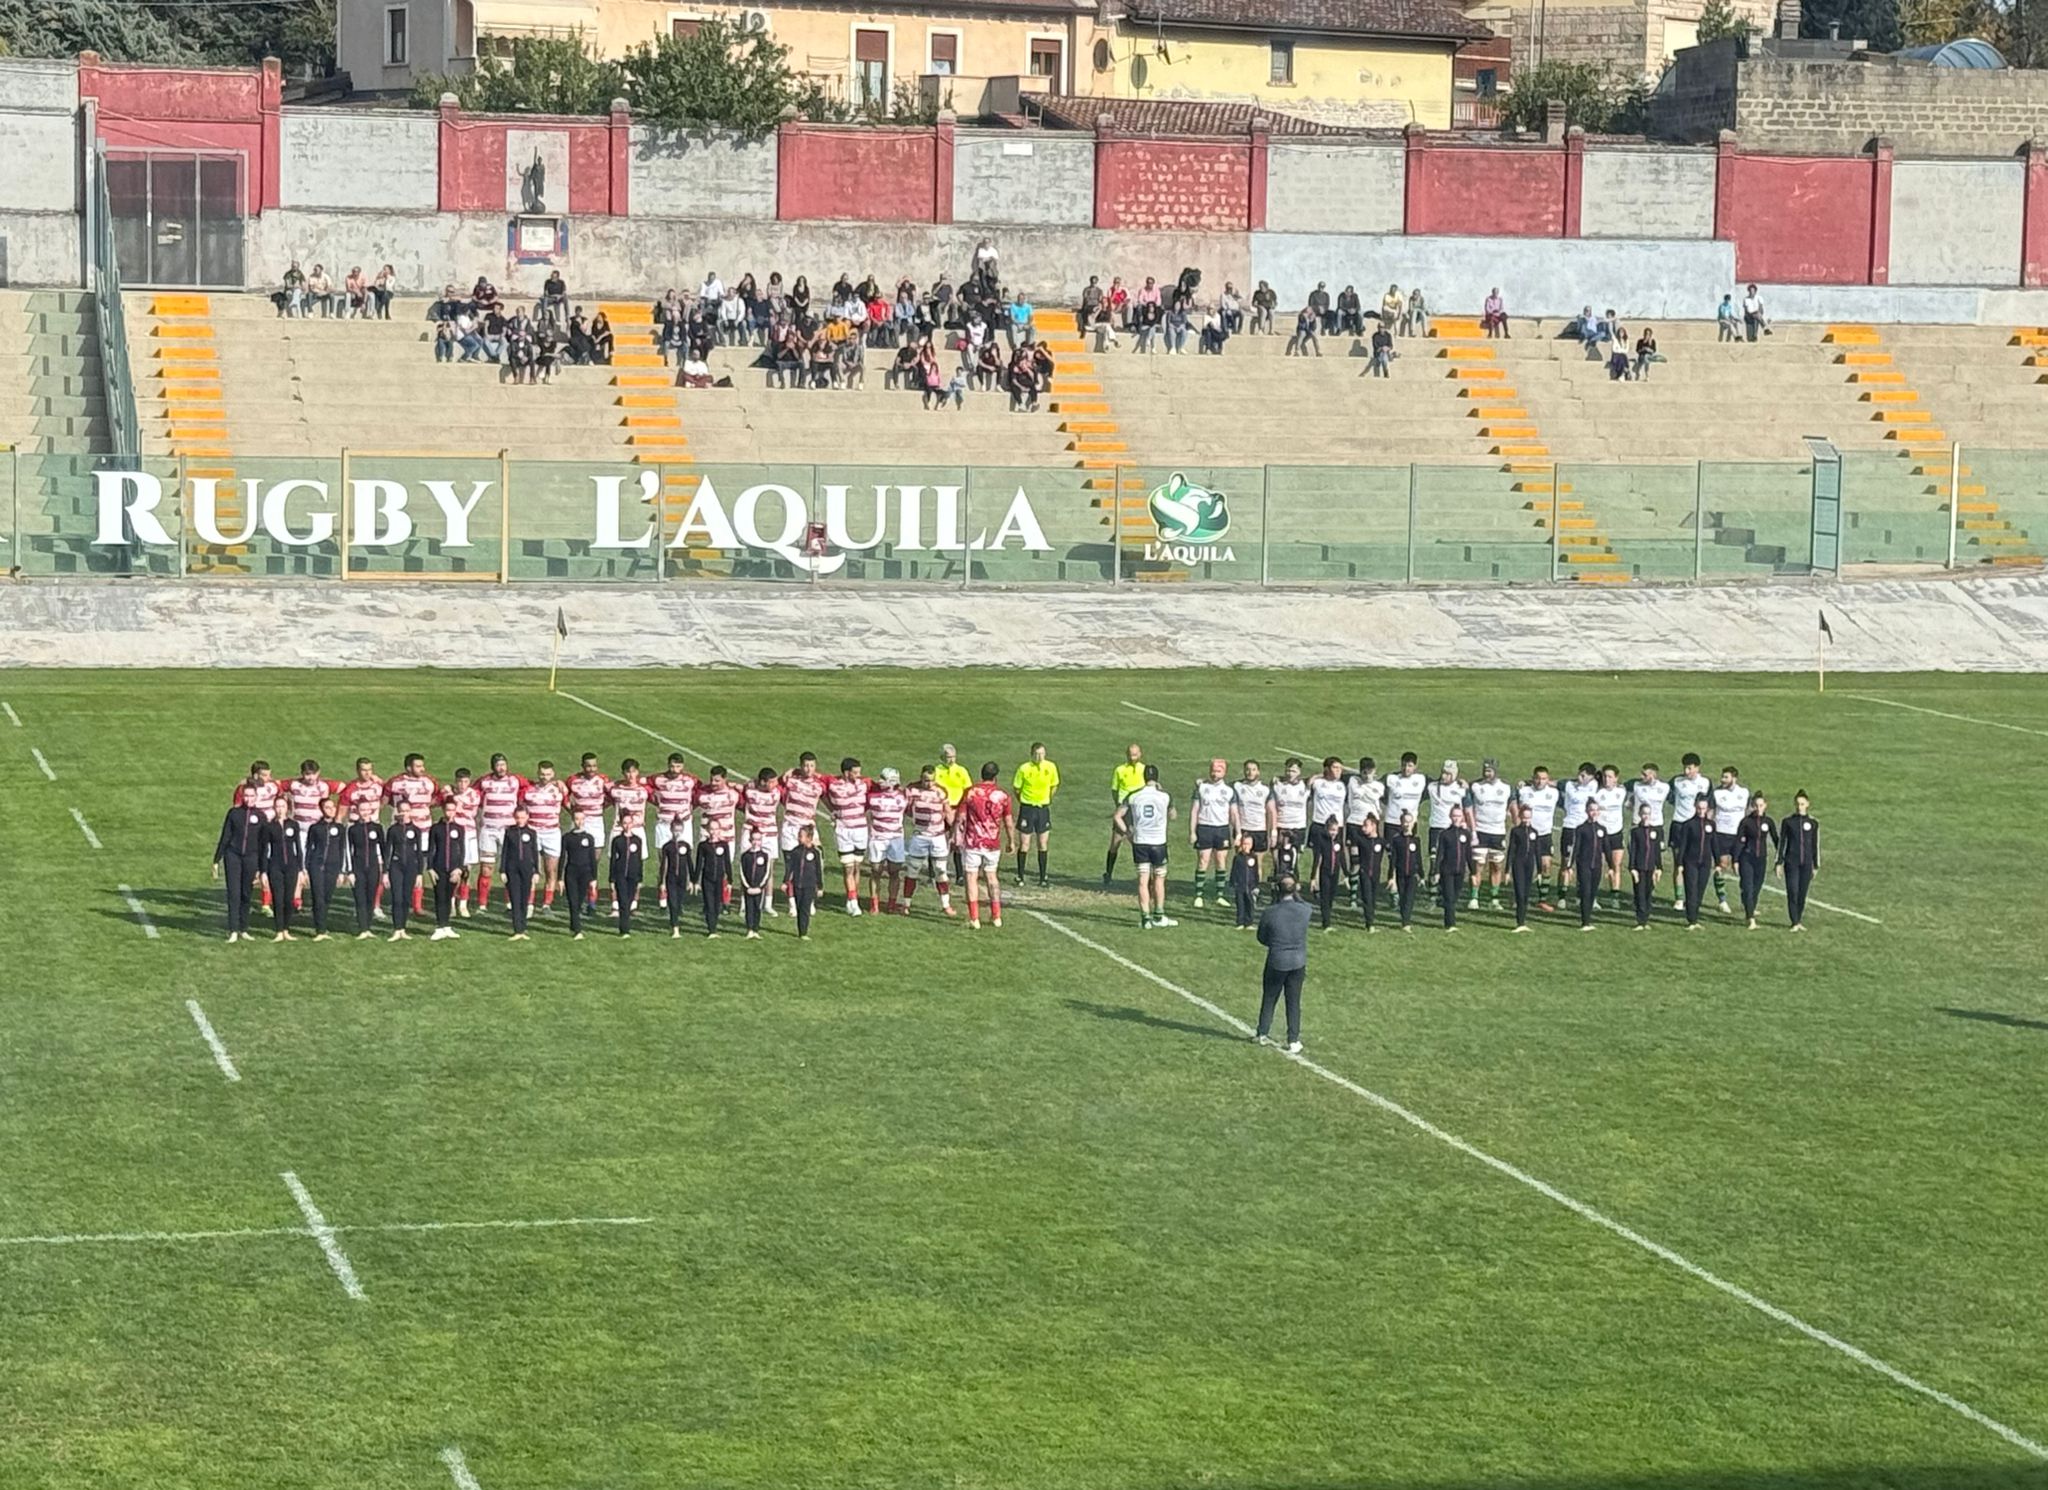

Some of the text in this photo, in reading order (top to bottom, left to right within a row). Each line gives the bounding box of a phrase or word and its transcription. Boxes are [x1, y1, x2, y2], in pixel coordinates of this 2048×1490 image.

[90, 469, 1056, 574] RUGBY L'AQUILA
[1144, 541, 1236, 567] L'AQUILA
[1143, 804, 1155, 818] 8
